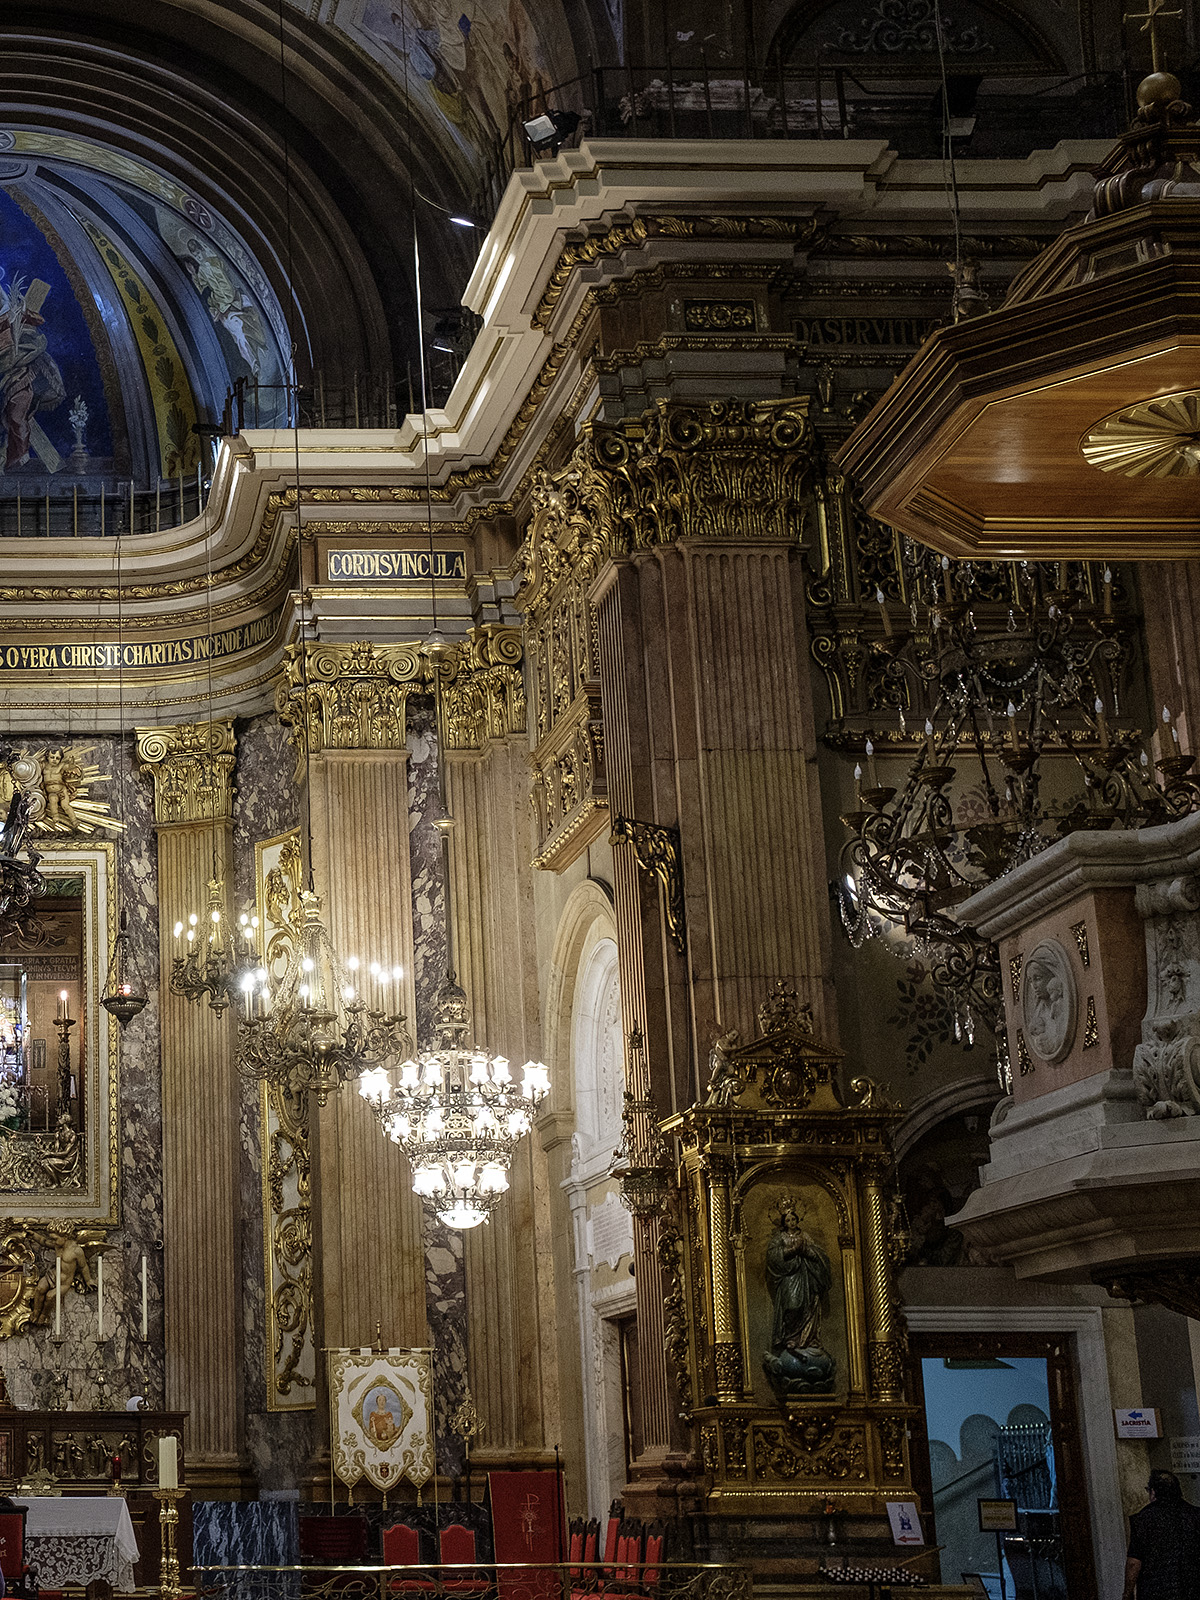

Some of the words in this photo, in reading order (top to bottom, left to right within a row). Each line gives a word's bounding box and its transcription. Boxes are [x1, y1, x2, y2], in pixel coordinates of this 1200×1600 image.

[61, 646, 122, 667] CHRISTE
[123, 640, 191, 666] CHARITAS
[193, 628, 243, 660] INCENDE
[17, 957, 40, 965] MARIA
[1121, 1419, 1151, 1427] SACRISTÍA
